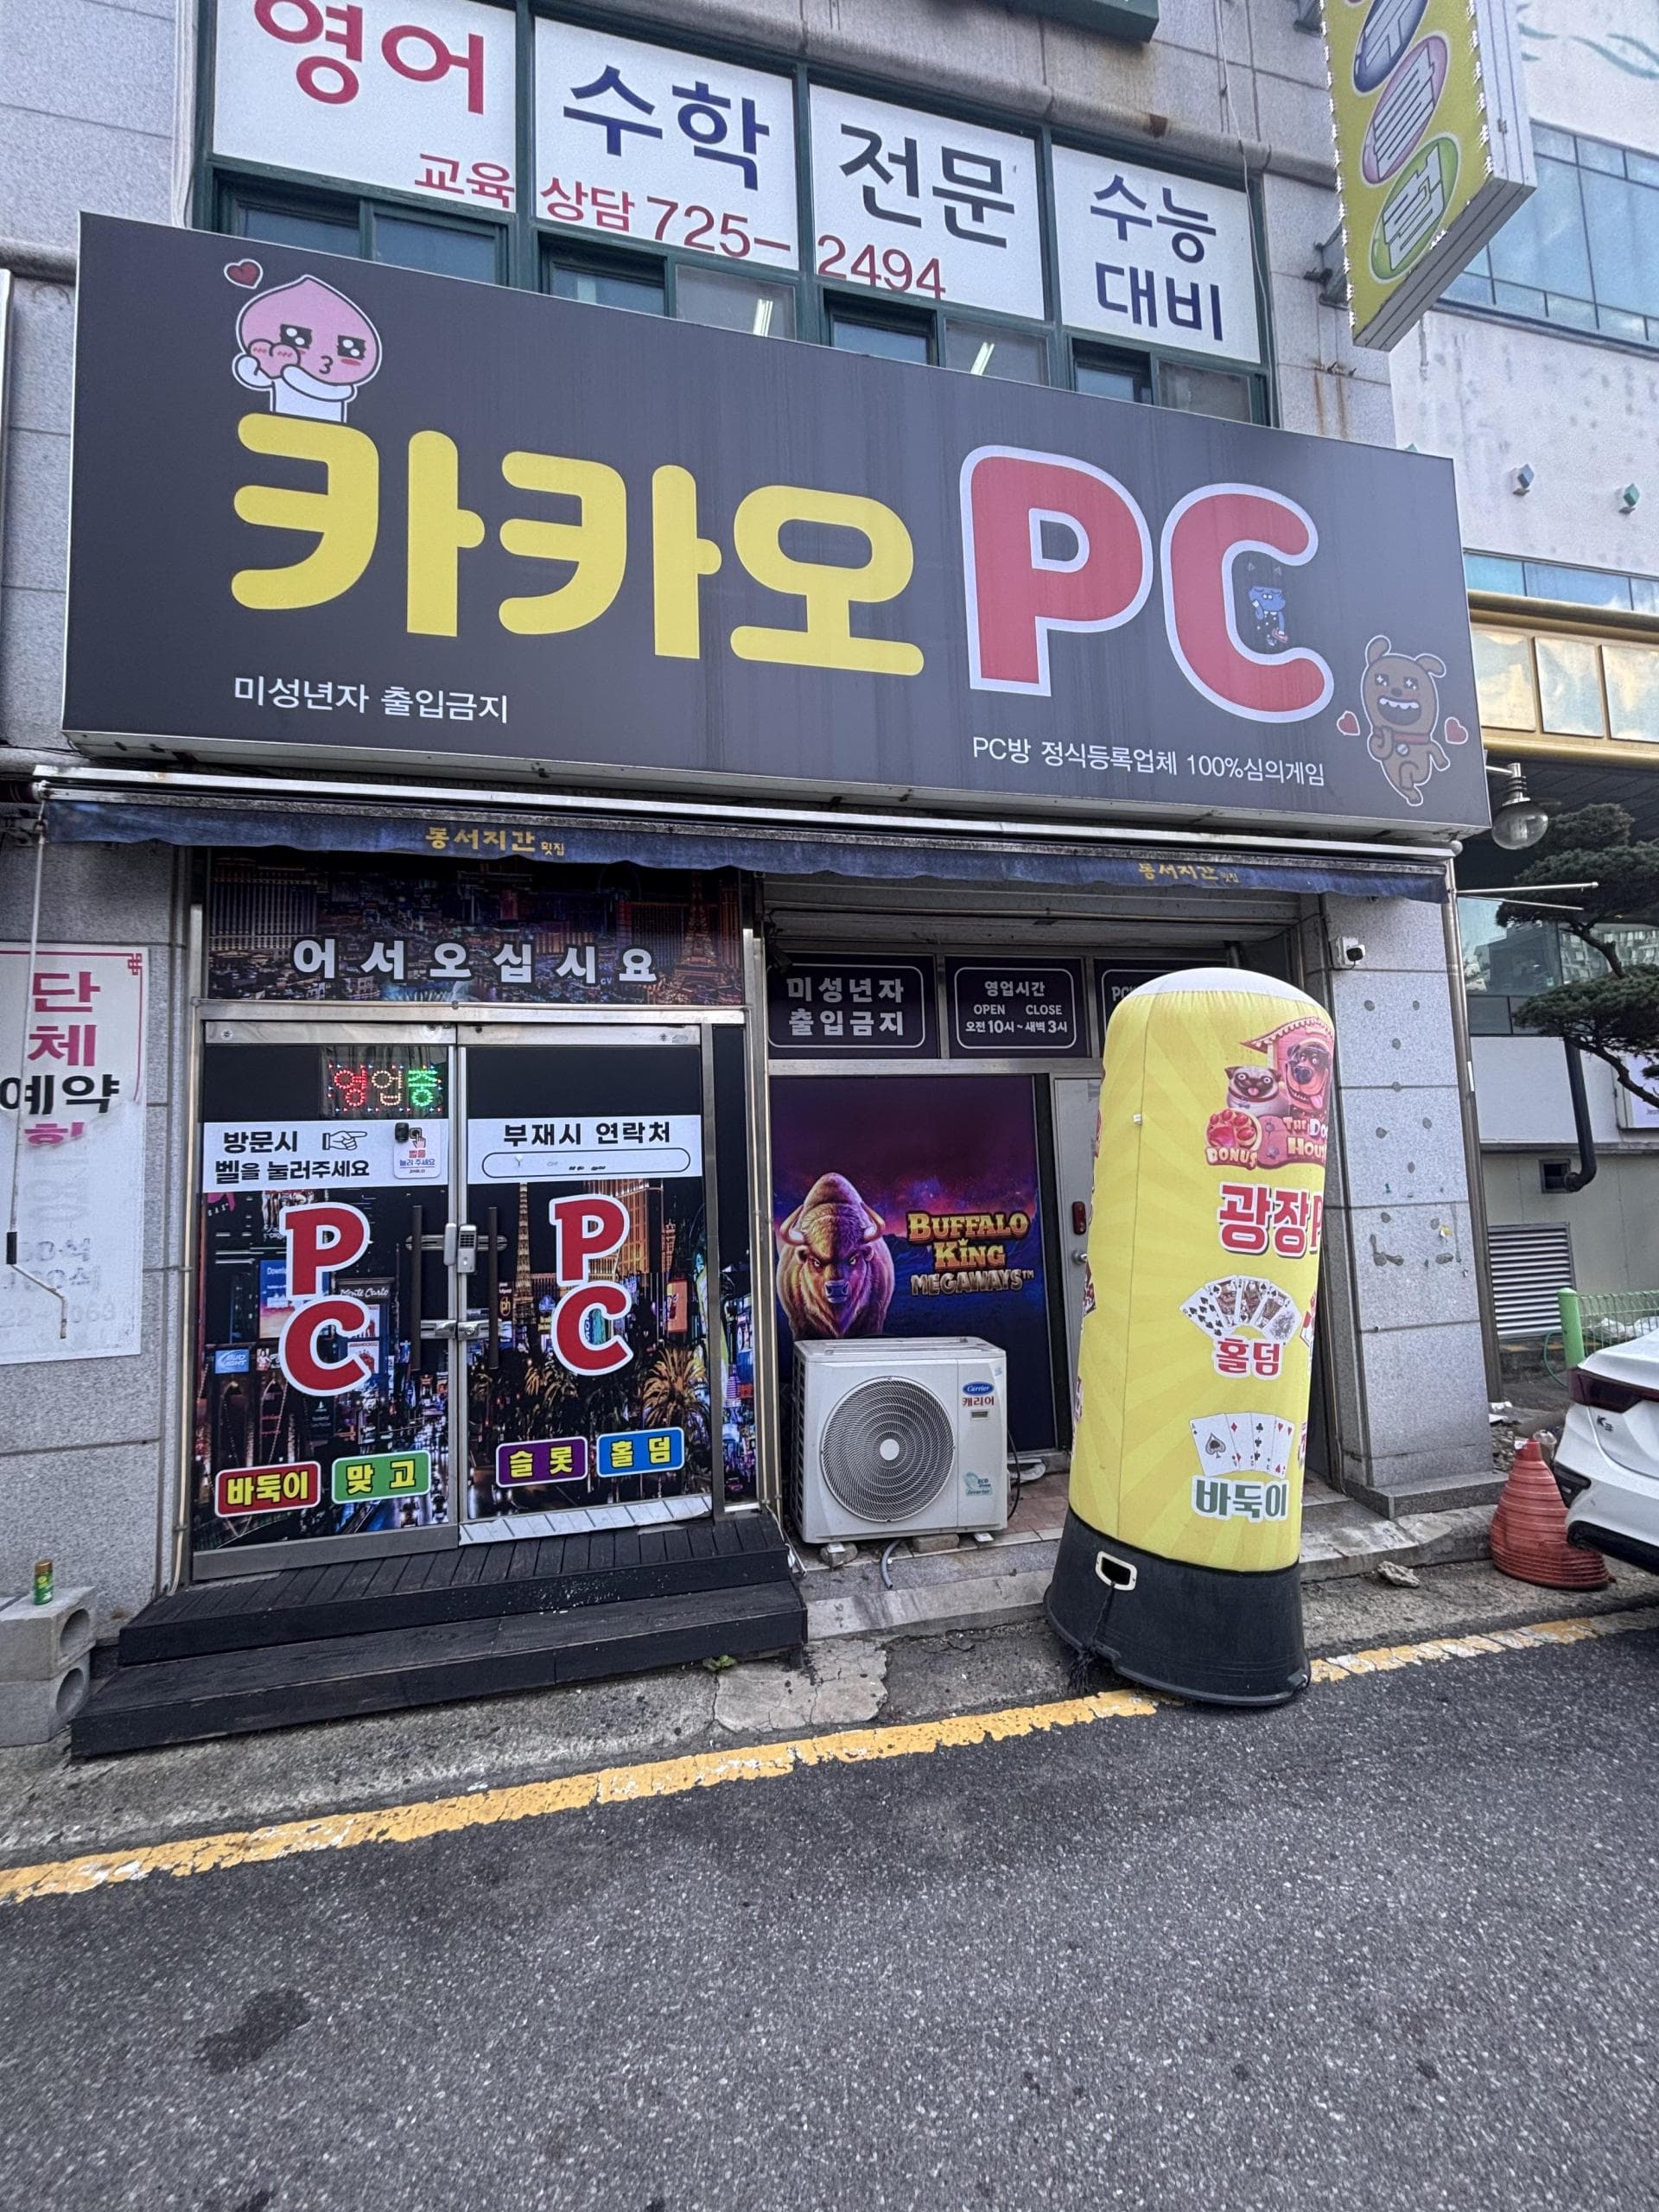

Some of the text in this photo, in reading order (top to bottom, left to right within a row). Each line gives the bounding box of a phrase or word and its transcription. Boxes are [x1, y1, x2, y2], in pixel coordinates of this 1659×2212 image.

[254, 0, 1015, 248] 영어 수학 전문
[415, 153, 514, 208] 교육
[540, 177, 635, 232] 상담
[1090, 175, 1217, 264] 수능
[1095, 262, 1224, 341] 대비
[232, 413, 1334, 722] 카카오 PC
[235, 676, 507, 724] 미성년자 출입금지
[973, 737, 1325, 786] PC방 정식등록업체 100%심의게임
[425, 827, 536, 853] 동서지간
[1138, 862, 1219, 880] 동서지간
[786, 977, 904, 1004] 미성년자
[984, 982, 1046, 997] 영업시간
[1111, 986, 1135, 1001] PC
[788, 1008, 904, 1037] 출입금지
[973, 1004, 1063, 1015] OPEN CLOSE
[965, 1021, 986, 1033] 오전
[988, 1020, 1014, 1033] 10시
[1025, 1021, 1046, 1033] 새벽
[1047, 1020, 1068, 1033] 3시
[0, 1074, 119, 1116] 예약
[334, 1069, 437, 1107] 영업중
[224, 1131, 297, 1154] 방문시
[504, 1122, 670, 1147] 부재시 연락처
[215, 1160, 370, 1184] 벨을 눌러주세요
[1205, 1147, 1258, 1167] BONUS
[907, 1212, 1029, 1243] BUFFALO
[1216, 1338, 1280, 1376] 홀덤
[963, 1396, 995, 1408] 캐리어
[967, 1384, 990, 1393] Carrier
[510, 1444, 574, 1478] 슬롯
[610, 1434, 671, 1468] 홀덤
[226, 1469, 309, 1507] 바둑이
[1196, 1478, 1287, 1519] 바둑이
